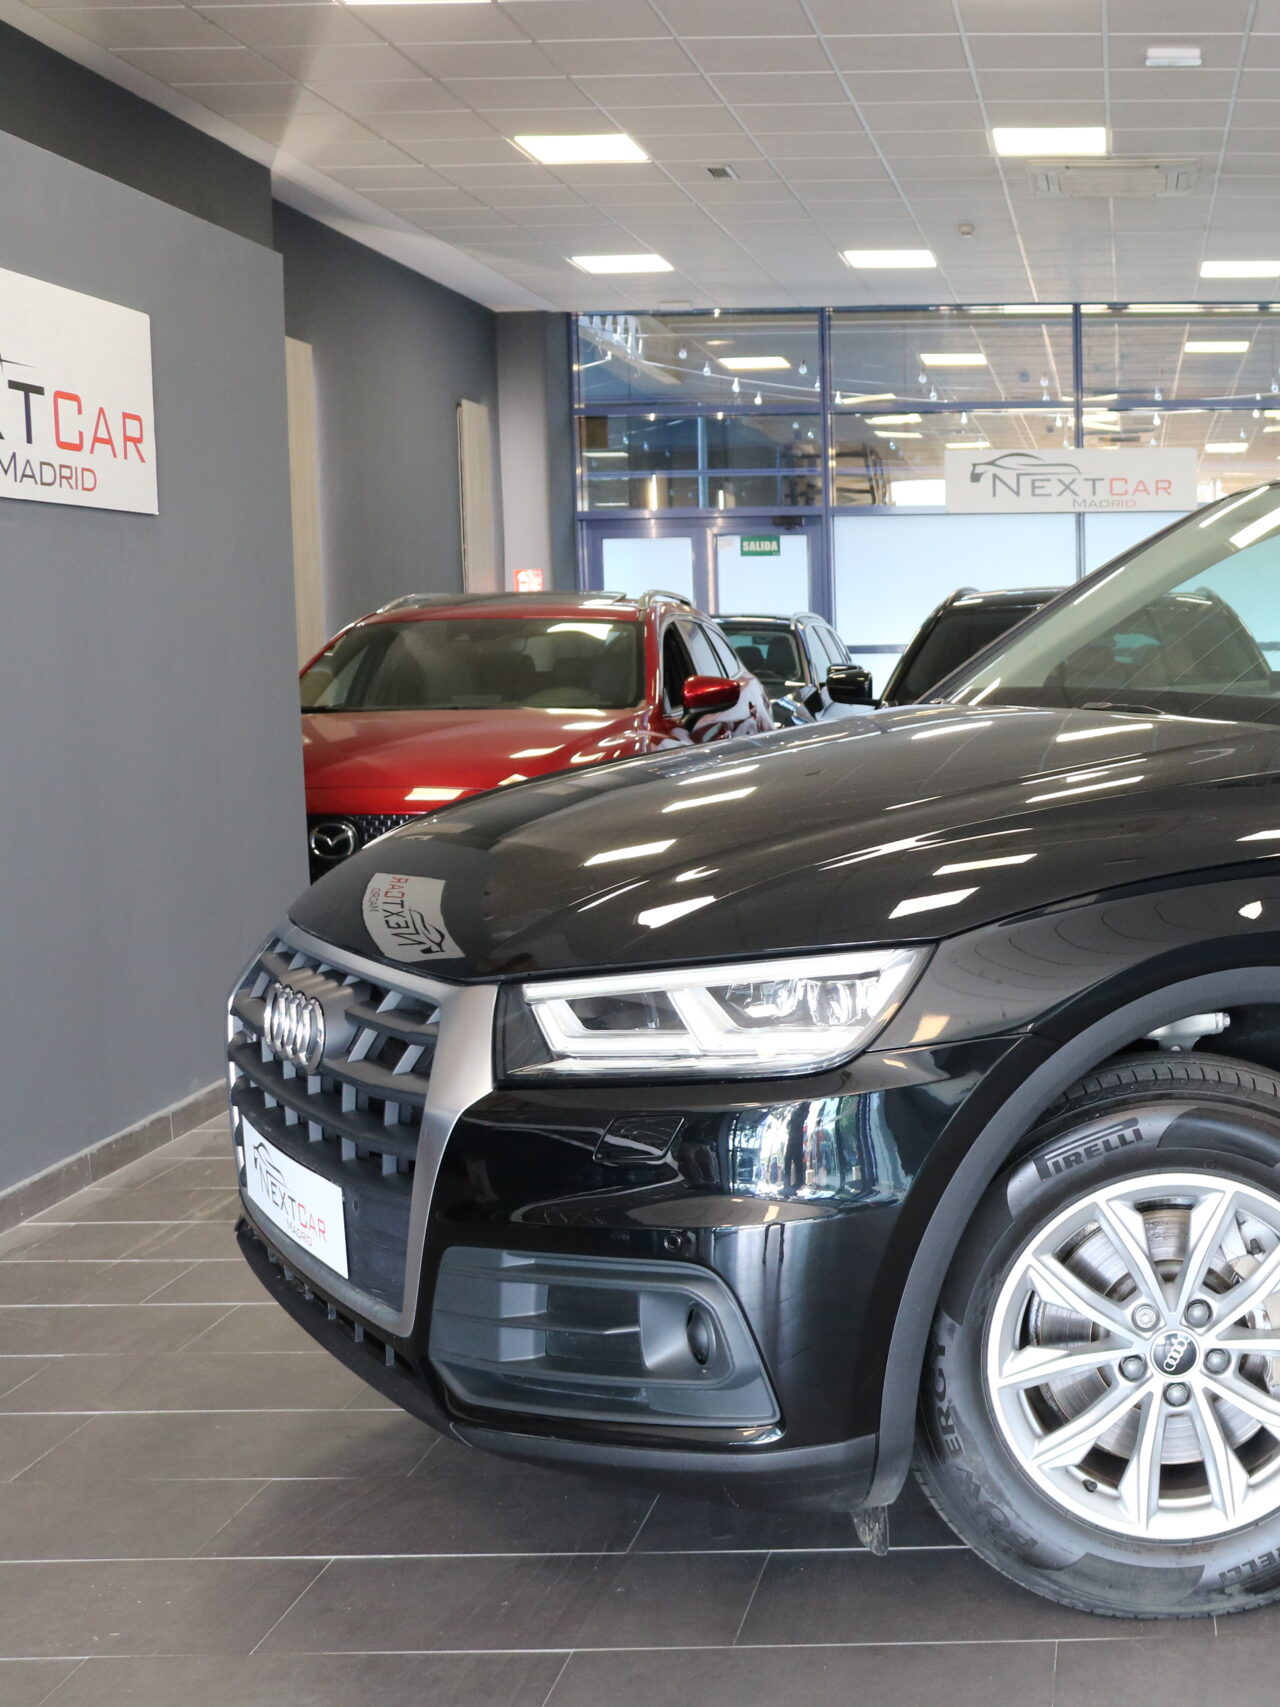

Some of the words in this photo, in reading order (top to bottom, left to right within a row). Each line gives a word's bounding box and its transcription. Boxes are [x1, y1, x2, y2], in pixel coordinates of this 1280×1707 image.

[0, 379, 146, 464] TCAR
[992, 472, 1172, 498] NEXTCAR
[1072, 499, 1137, 509] MADRID
[742, 540, 779, 552] SALIDA
[1032, 1117, 1144, 1181] PIRELLI
[258, 1162, 328, 1243] NEXTCAR
